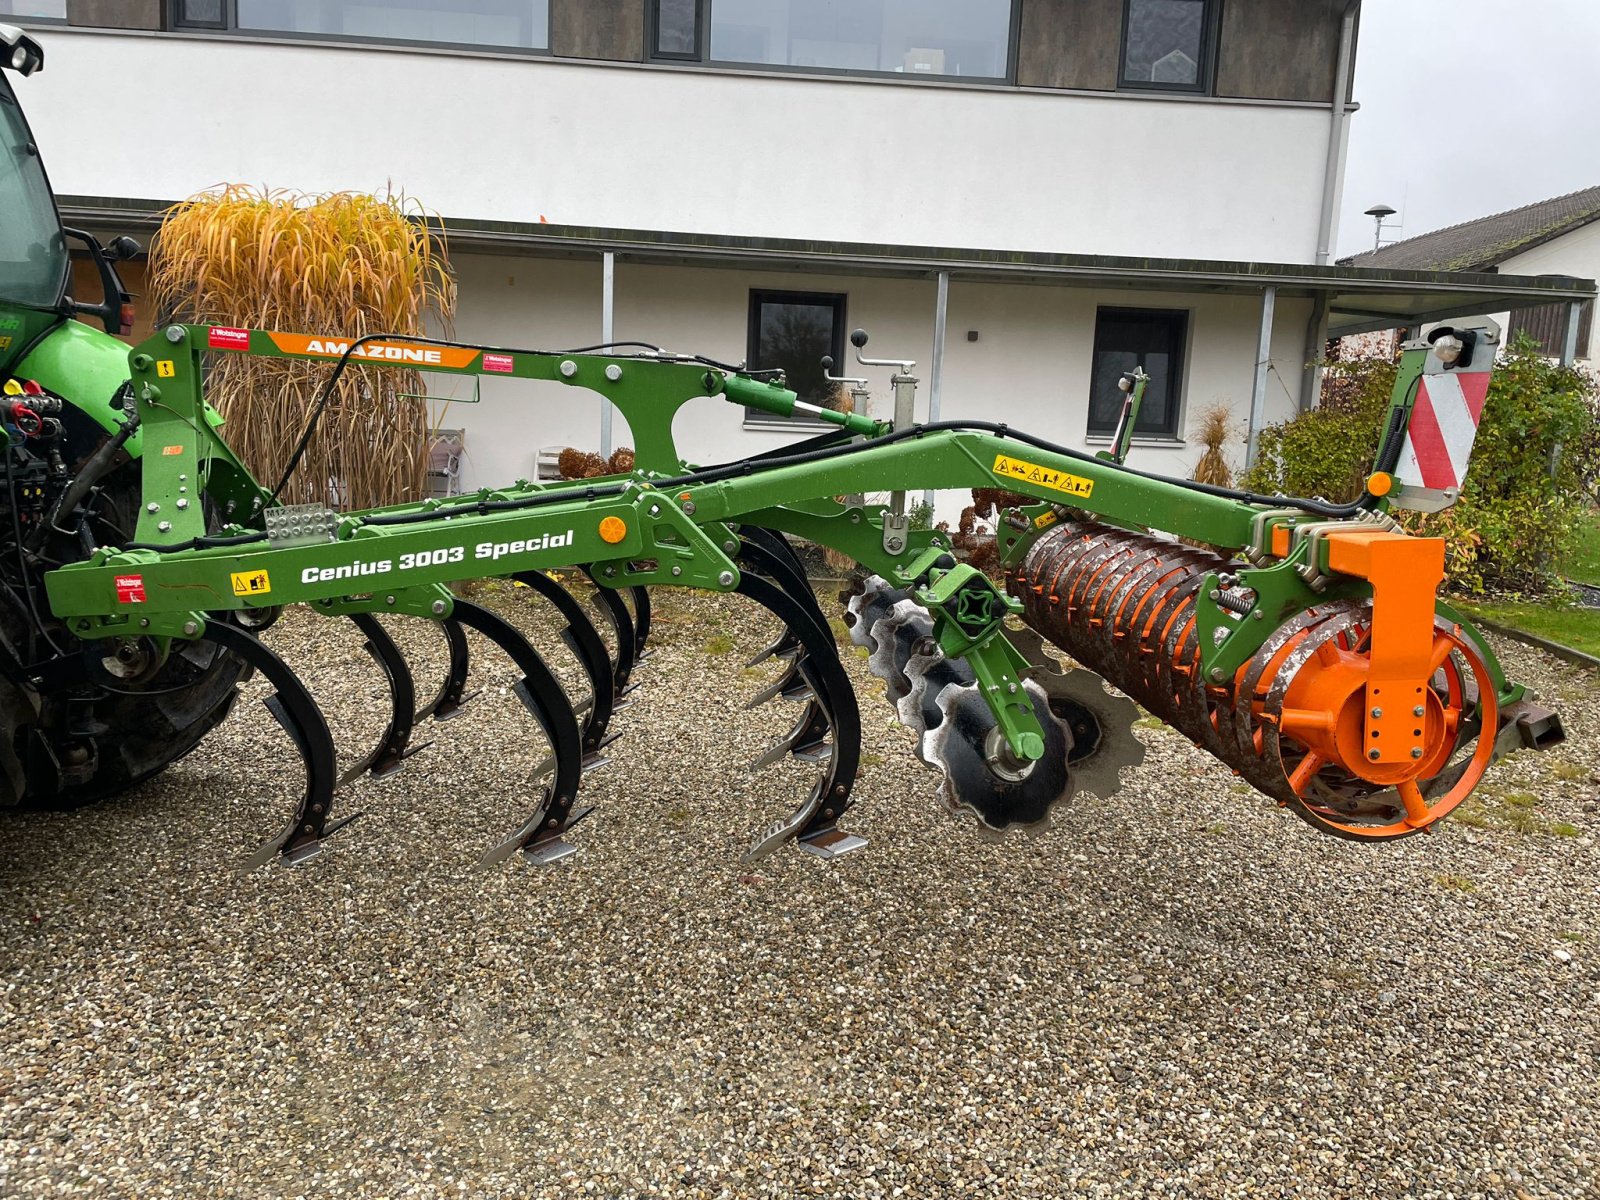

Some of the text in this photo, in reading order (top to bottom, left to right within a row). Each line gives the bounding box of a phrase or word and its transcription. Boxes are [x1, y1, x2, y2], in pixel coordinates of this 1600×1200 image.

[306, 340, 442, 363] AMAZONE
[301, 530, 574, 584] Cenius 3003 Special
